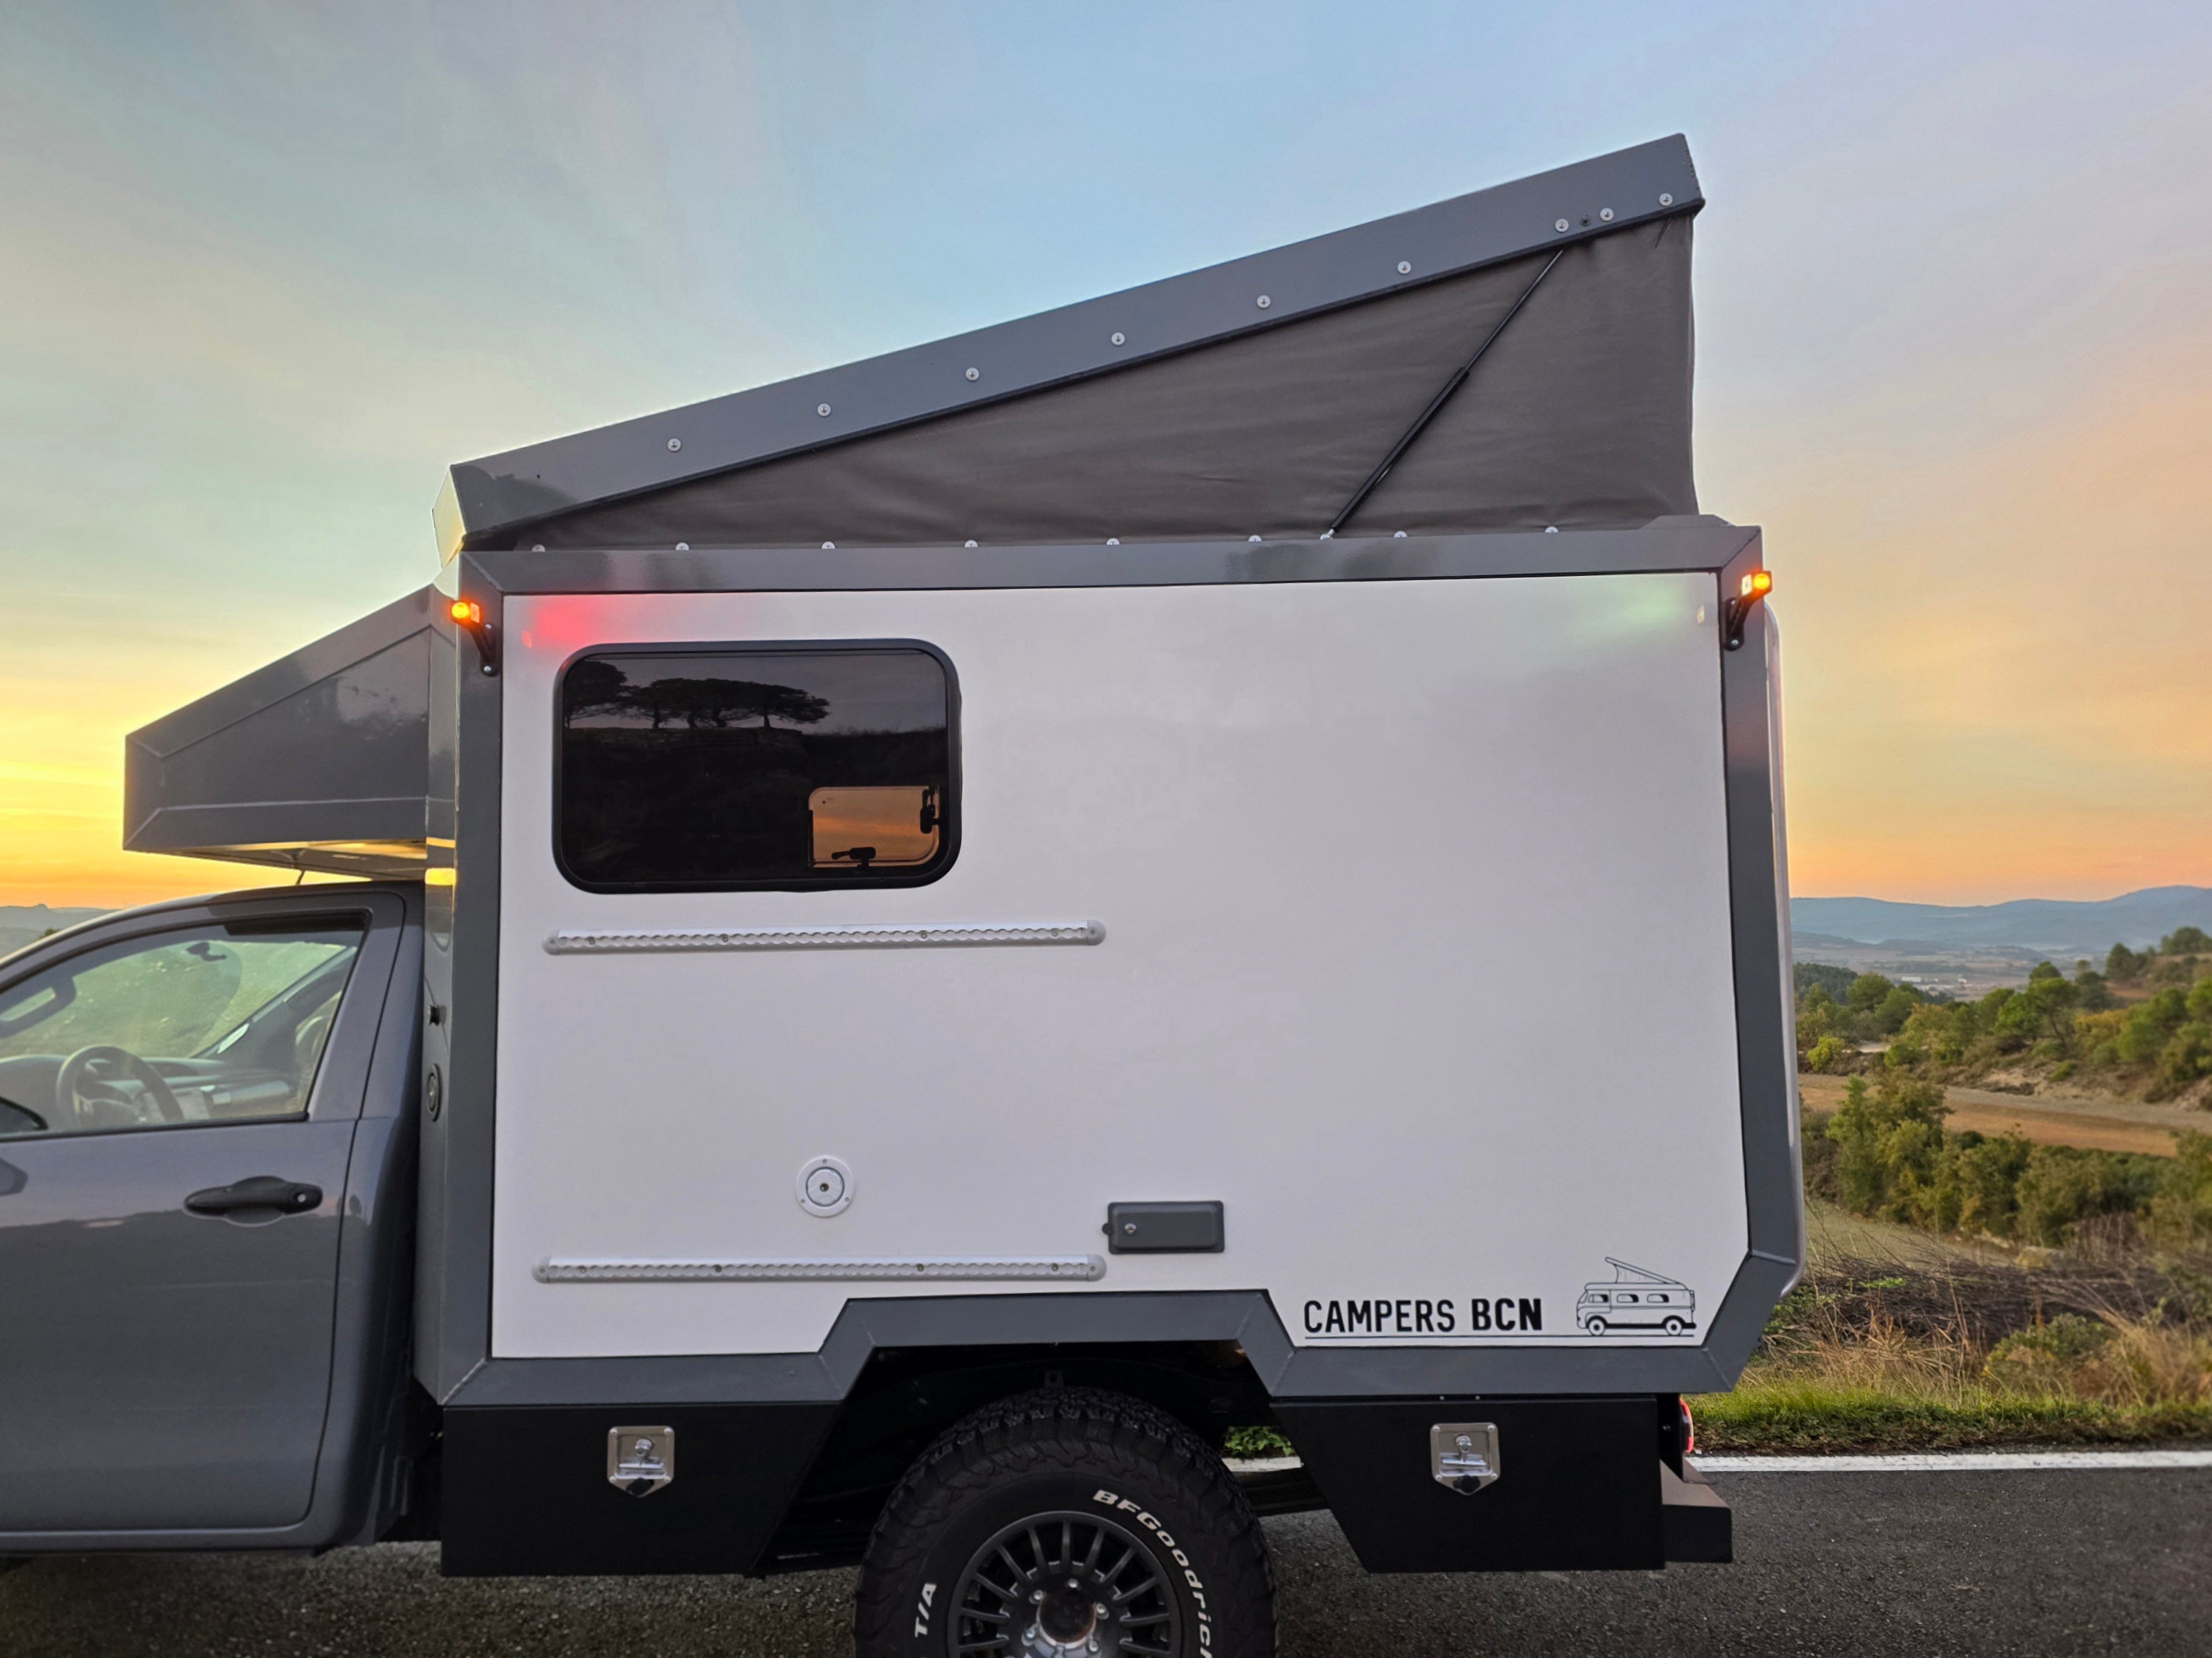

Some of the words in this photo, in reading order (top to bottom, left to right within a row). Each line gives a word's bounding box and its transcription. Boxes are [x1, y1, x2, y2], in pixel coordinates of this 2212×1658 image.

[1303, 1300, 1455, 1333] CAMPERS
[1471, 1298, 1542, 1331] BCN
[914, 1583, 937, 1638] T/A
